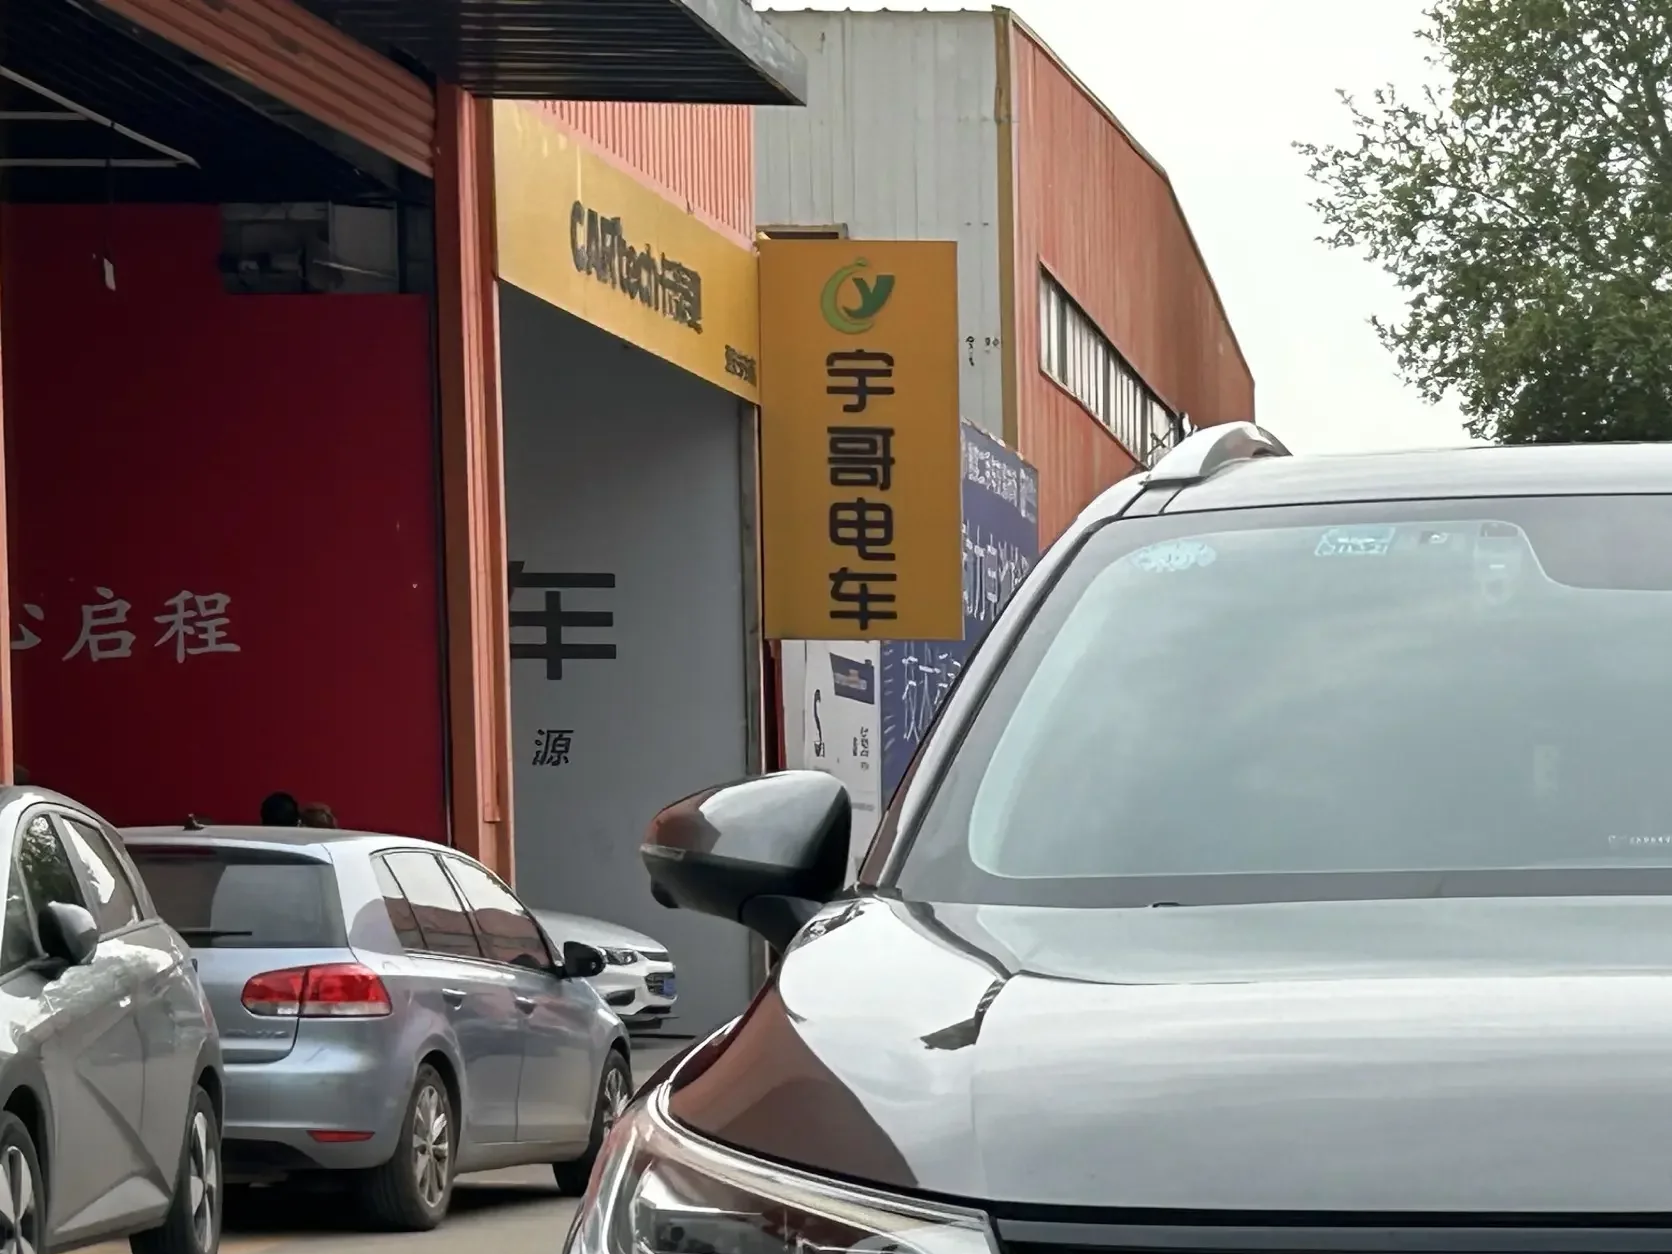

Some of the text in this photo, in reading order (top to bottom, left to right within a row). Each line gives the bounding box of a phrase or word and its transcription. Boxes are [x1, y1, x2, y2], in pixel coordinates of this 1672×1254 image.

[826, 348, 898, 631] 宇哥电车
[532, 729, 574, 766] 源
